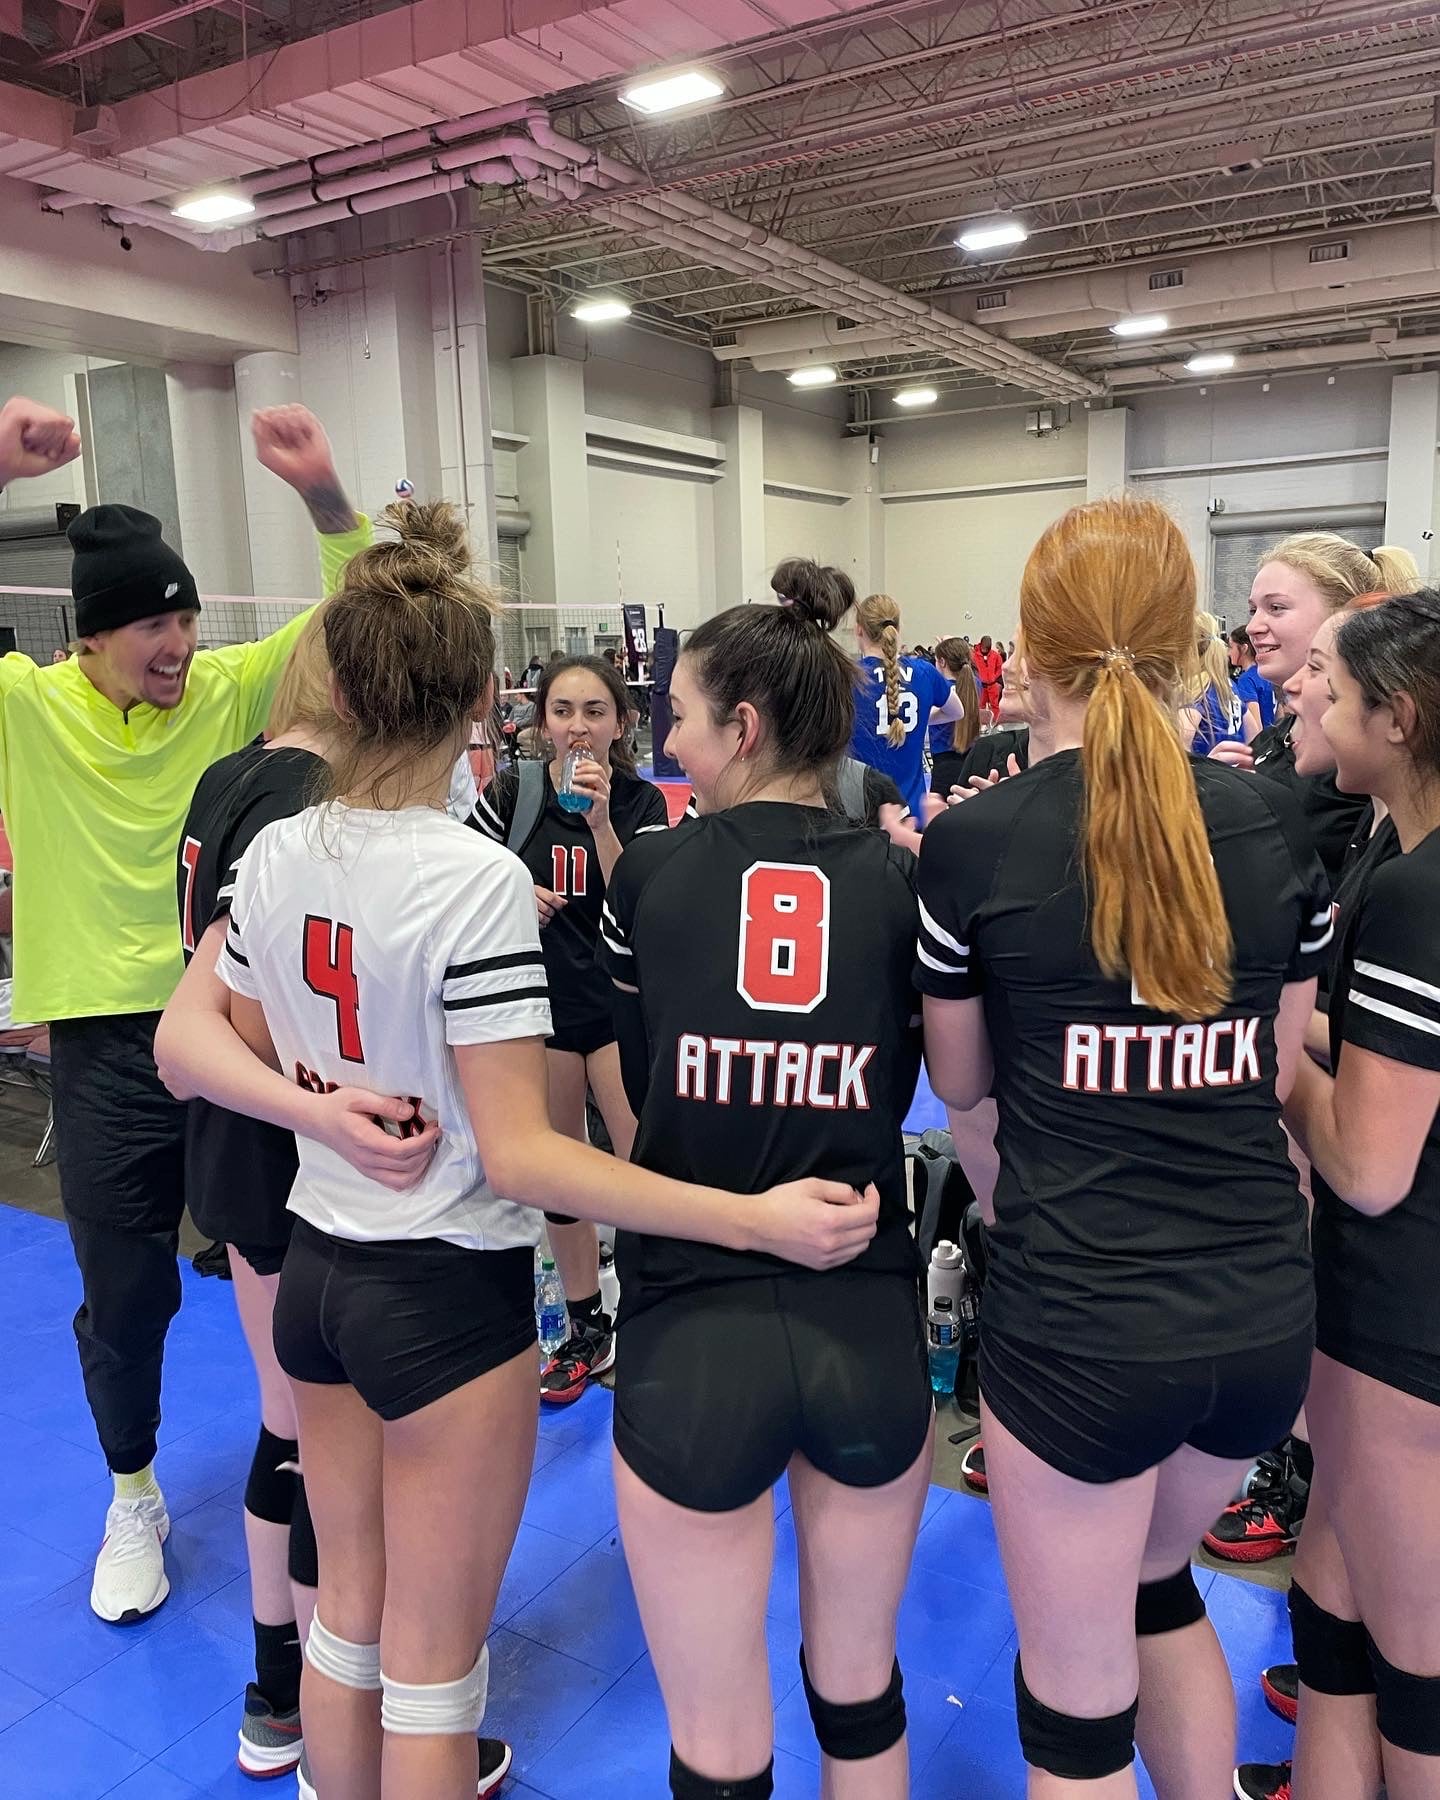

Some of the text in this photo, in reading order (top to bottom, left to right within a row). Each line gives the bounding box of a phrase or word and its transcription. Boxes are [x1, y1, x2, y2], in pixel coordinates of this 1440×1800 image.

[873, 666, 914, 683] TV
[875, 691, 919, 735] 13
[551, 844, 588, 897] 11
[736, 860, 831, 1014] 8
[302, 913, 366, 1065] 4
[676, 1032, 877, 1110] ATTACK
[1062, 1016, 1262, 1093] ATTACK
